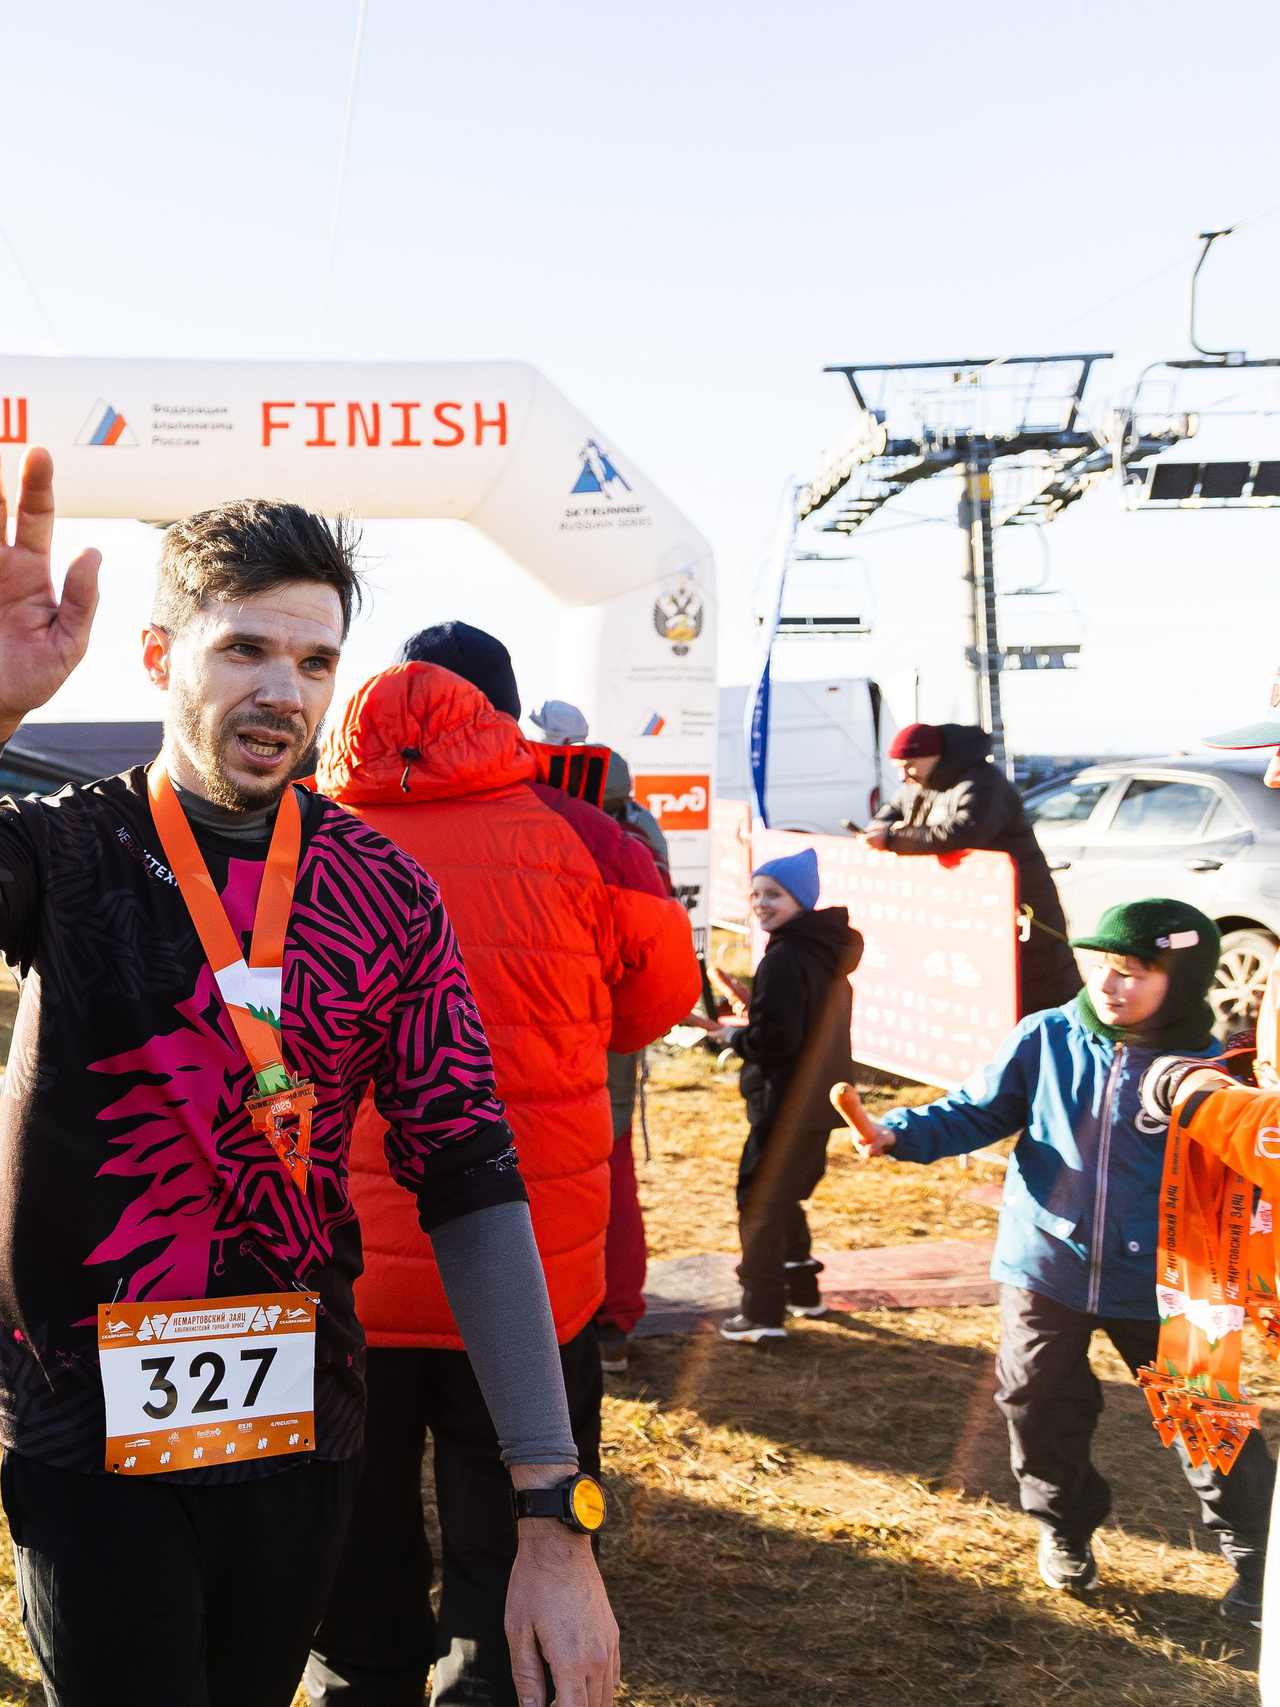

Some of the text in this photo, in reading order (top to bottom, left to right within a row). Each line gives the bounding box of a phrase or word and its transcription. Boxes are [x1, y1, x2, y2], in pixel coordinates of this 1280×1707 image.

[261, 401, 508, 447] FINISH
[270, 1100, 292, 1115] 2025
[1230, 1193, 1245, 1219] ЗАЯЦ
[173, 1311, 247, 1327] НЕМАРТОВСКИЙ ЗАЯЦ
[141, 1347, 278, 1420] 327
